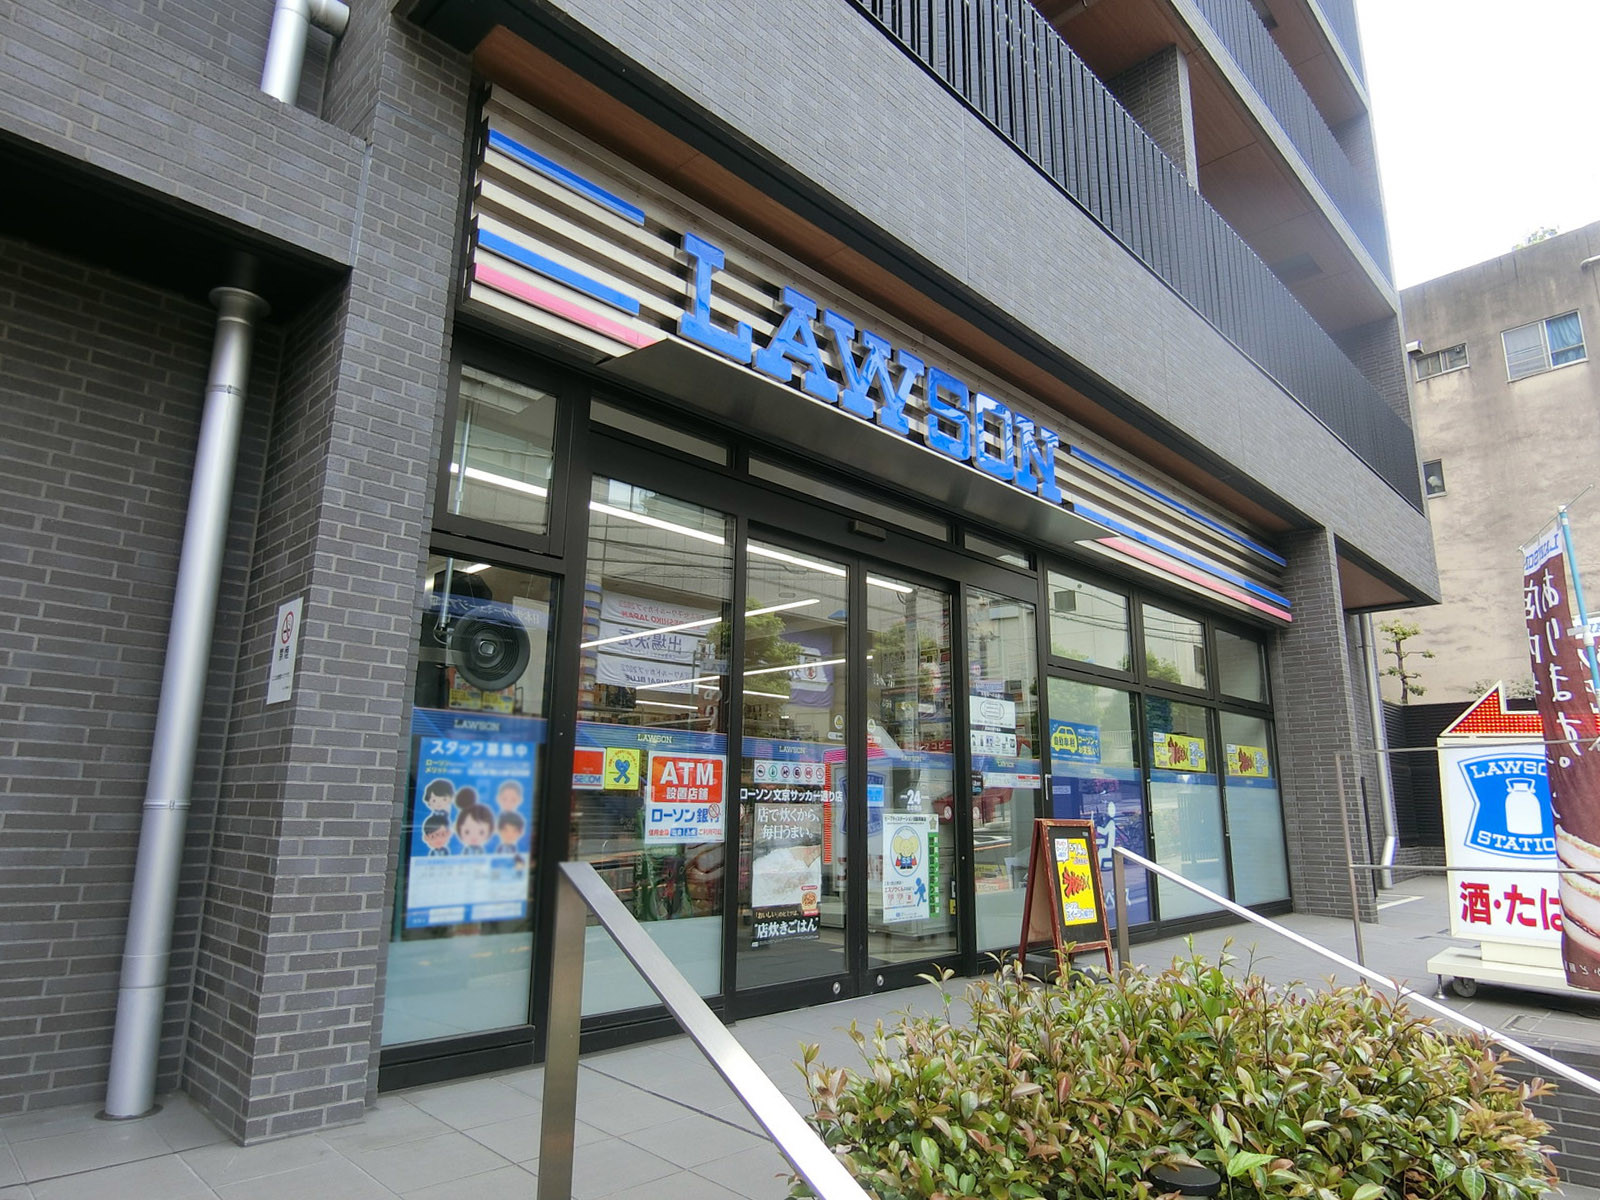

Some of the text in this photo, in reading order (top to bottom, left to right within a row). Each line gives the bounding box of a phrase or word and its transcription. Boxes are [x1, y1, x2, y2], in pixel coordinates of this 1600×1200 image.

[676, 231, 1062, 504] LAWSON
[637, 733, 672, 744] LAWSON
[430, 740, 529, 757] スタッフ募集中
[660, 761, 714, 786] ATM
[666, 786, 709, 801] 設置店舗
[740, 788, 844, 802] ローソン文京サッカー通り店
[757, 807, 821, 822] 店で炊くから、
[762, 825, 814, 840] 毎日うまい。
